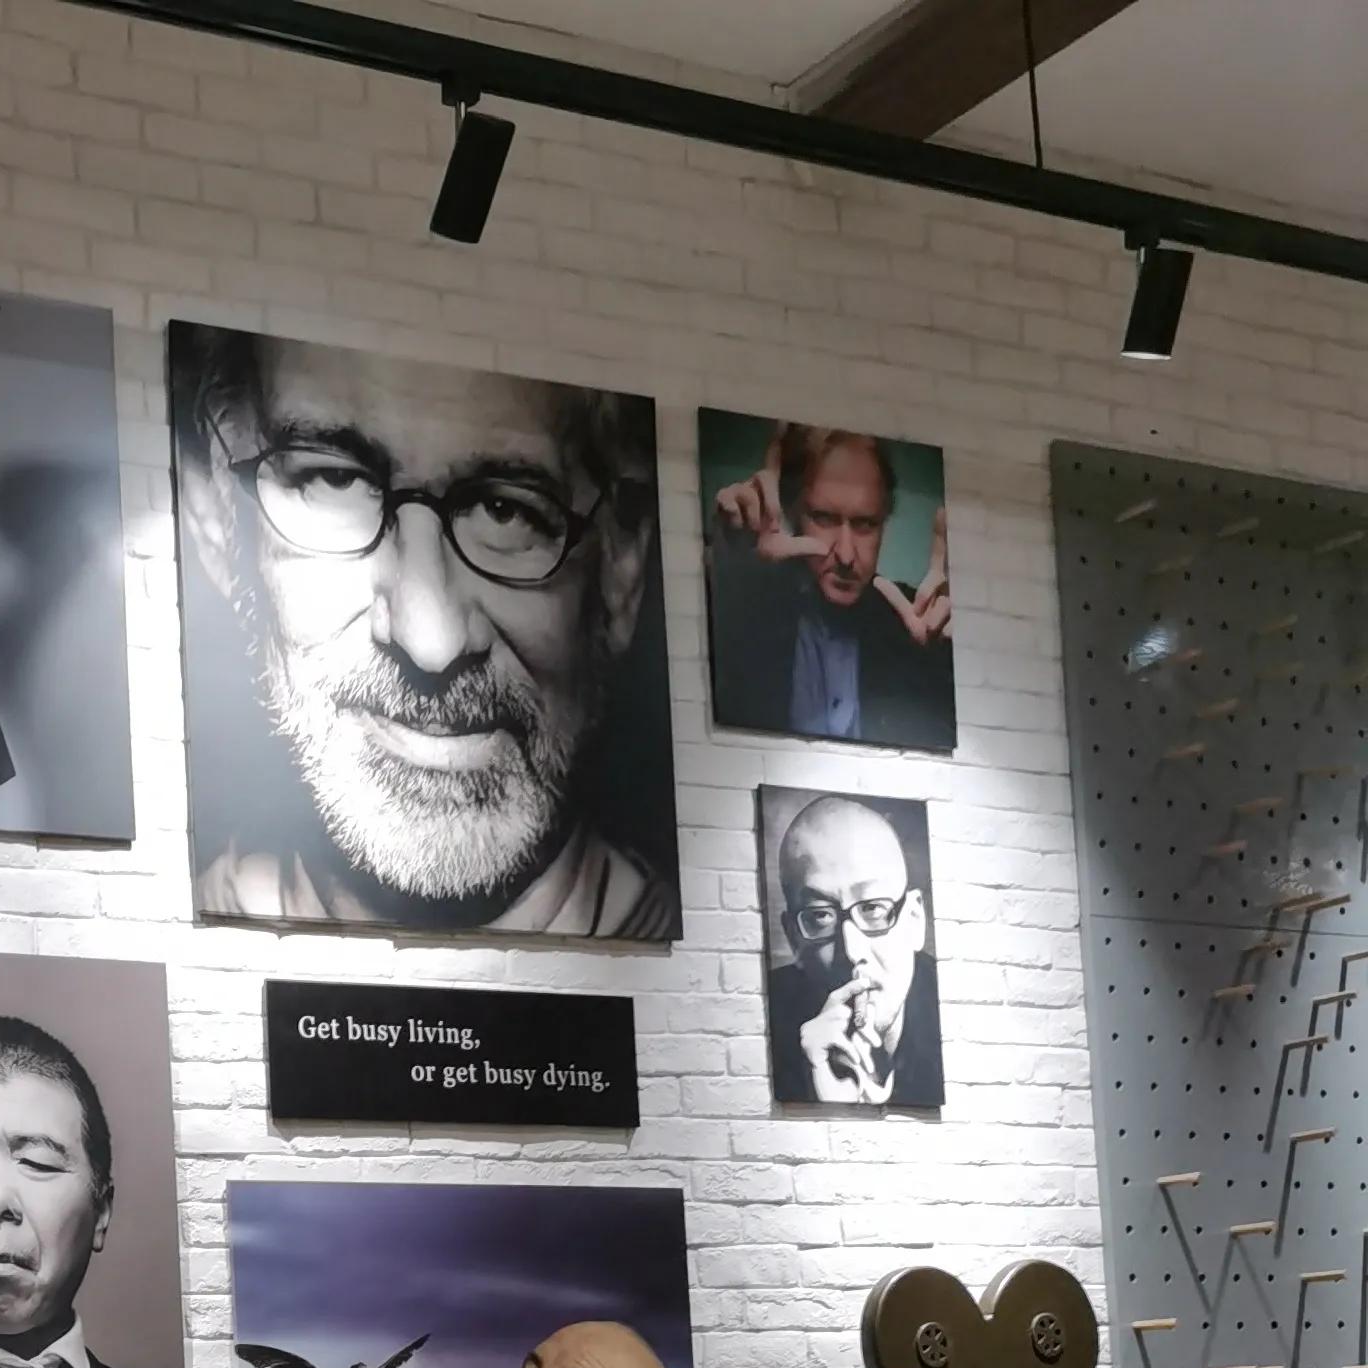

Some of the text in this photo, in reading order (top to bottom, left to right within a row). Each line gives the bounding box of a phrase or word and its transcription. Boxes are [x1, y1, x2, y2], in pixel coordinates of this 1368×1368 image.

[298, 1016, 480, 1050] Get busy living,
[410, 1061, 609, 1091] or get busy dying.
